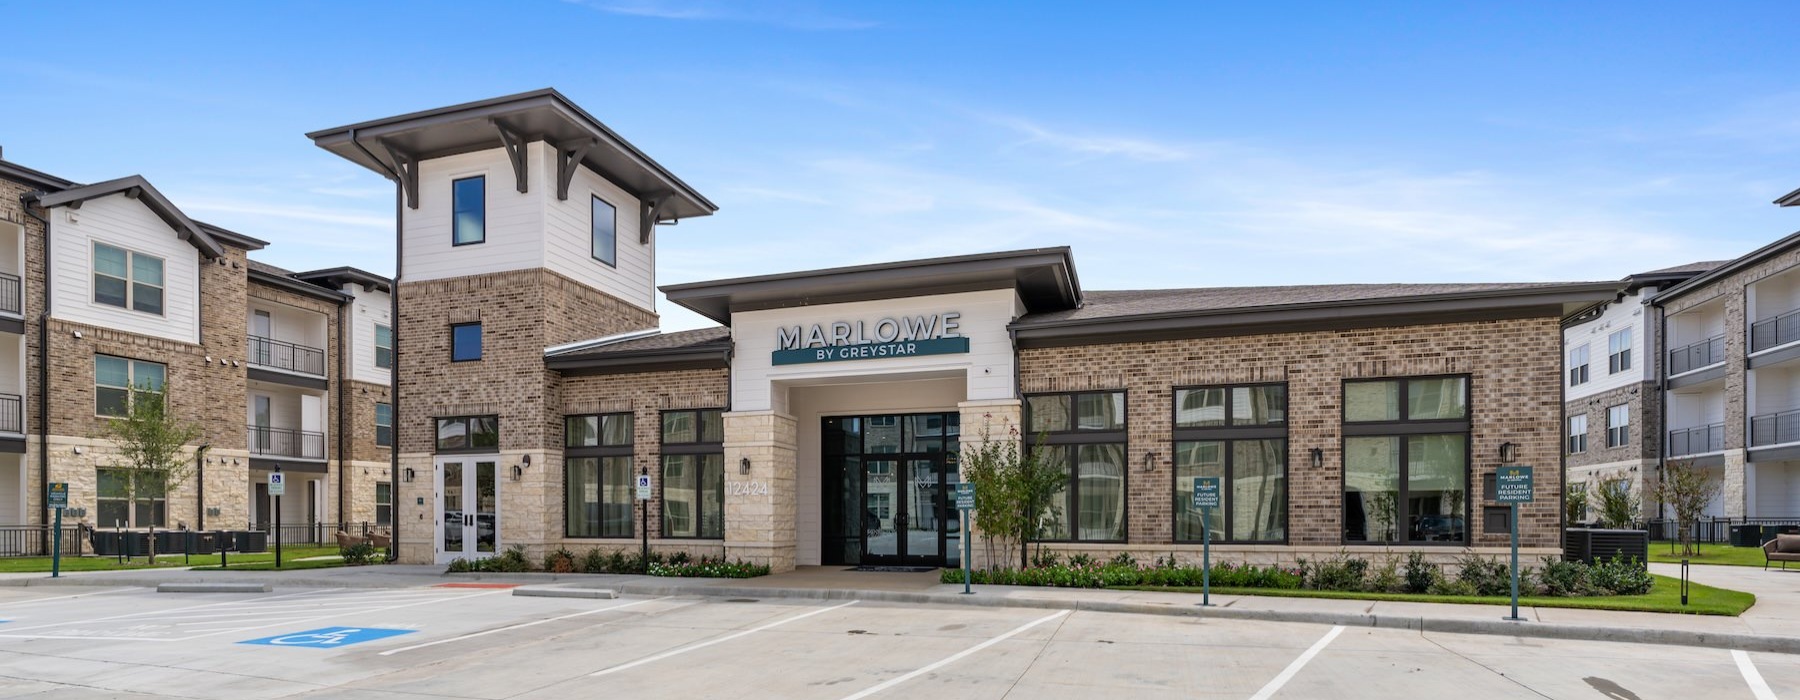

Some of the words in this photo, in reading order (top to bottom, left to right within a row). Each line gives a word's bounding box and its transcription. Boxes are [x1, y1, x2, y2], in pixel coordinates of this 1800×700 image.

[776, 312, 961, 351] MARLOWE
[816, 349, 834, 360] BY
[839, 343, 916, 358] GREYSTAR
[729, 481, 768, 496] 12424
